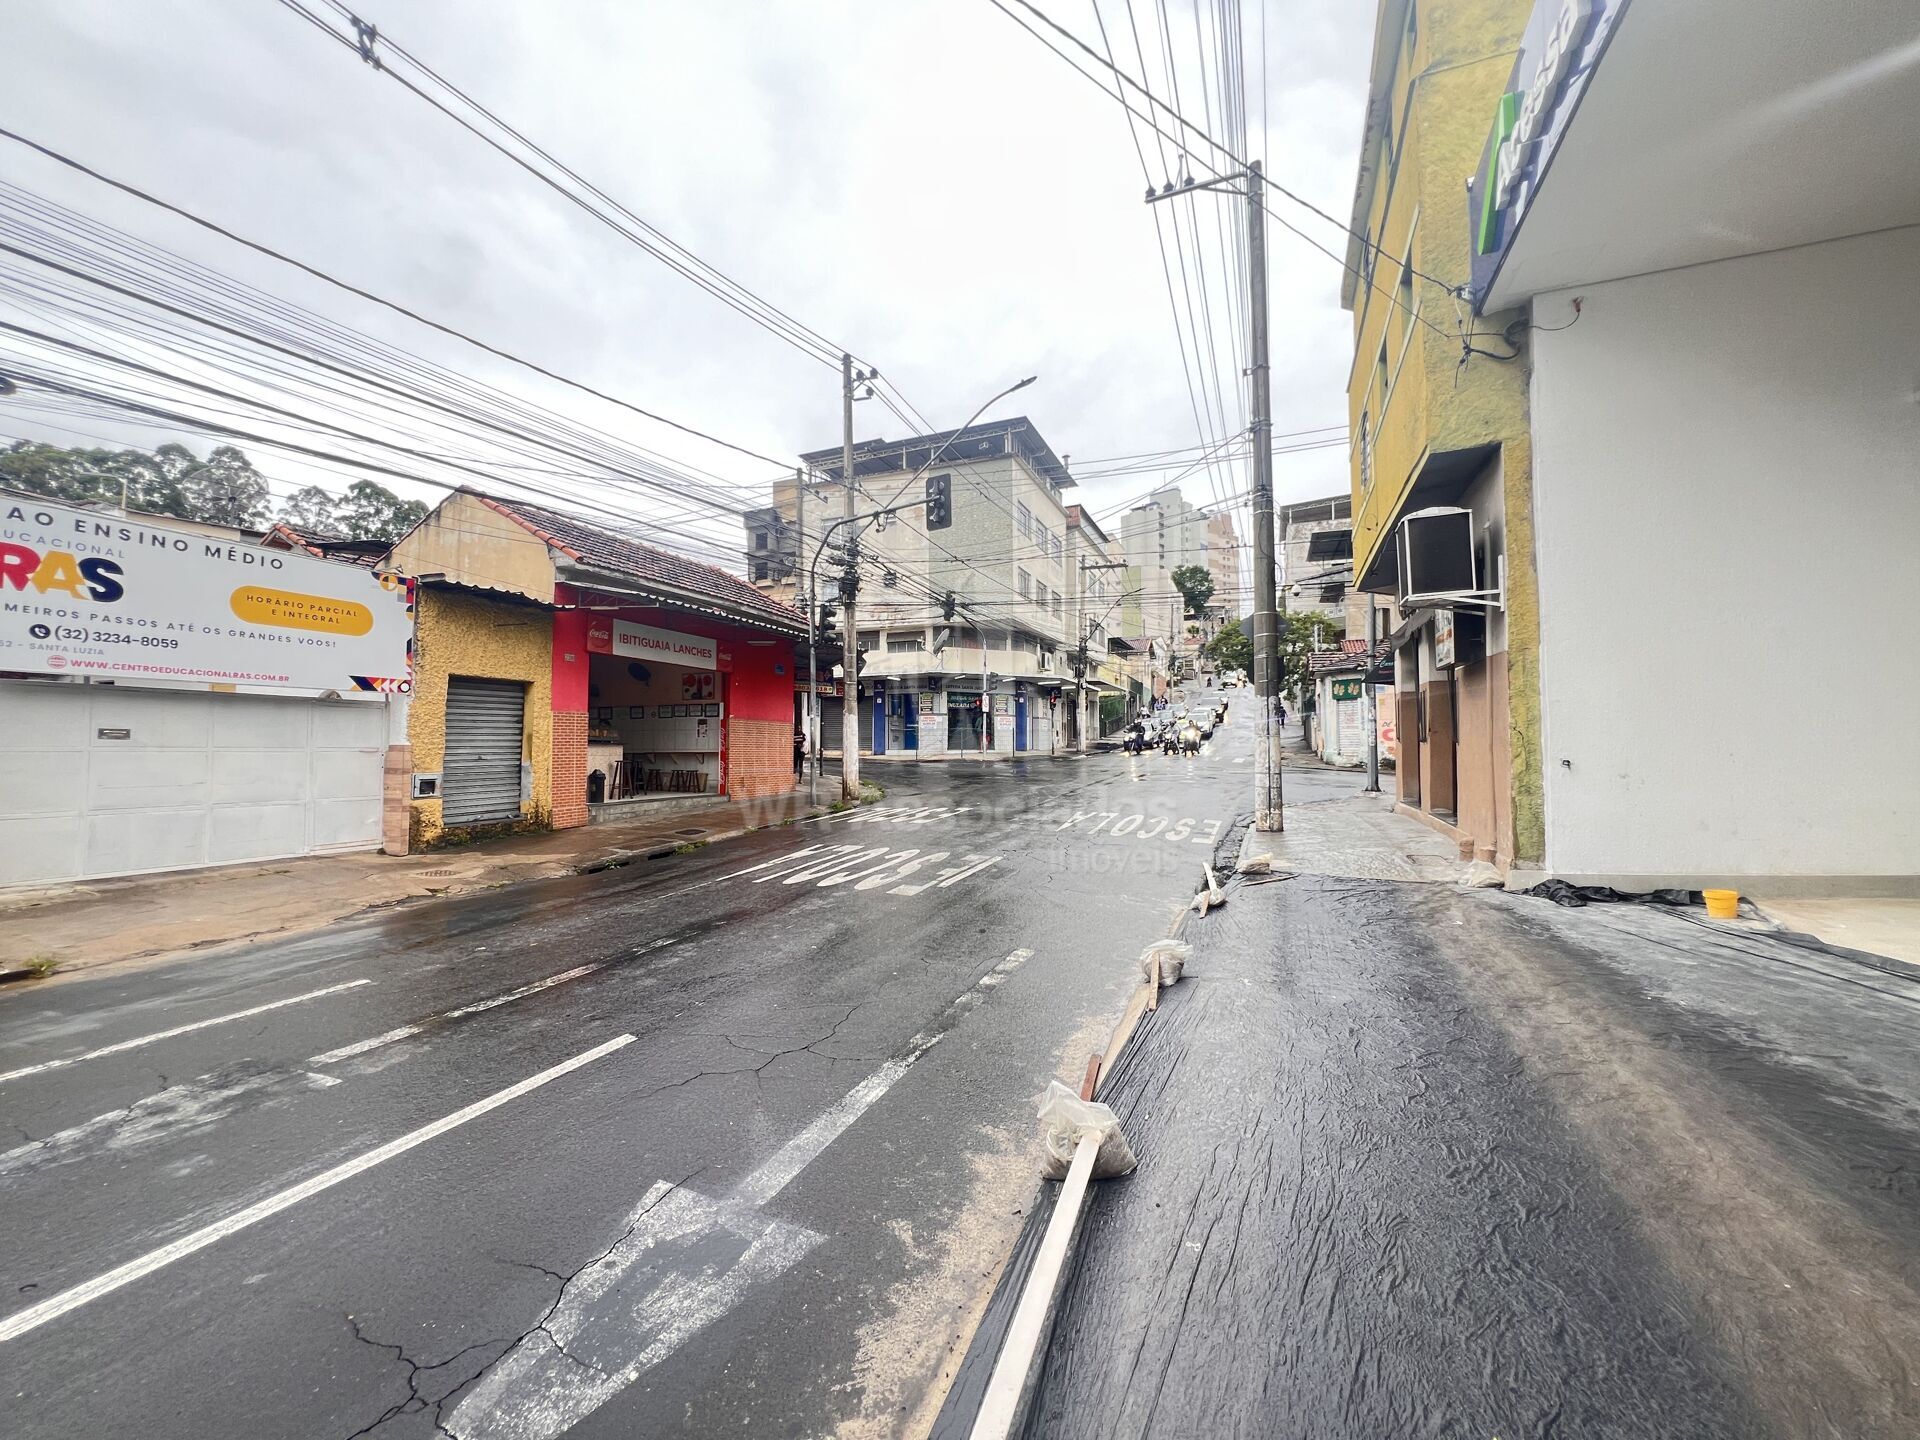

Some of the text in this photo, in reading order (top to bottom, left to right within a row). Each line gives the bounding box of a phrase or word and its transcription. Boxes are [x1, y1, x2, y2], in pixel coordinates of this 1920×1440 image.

[6, 507, 283, 570] AO ENSINO MÉDIO
[246, 594, 358, 617] HORÁRIO PARCIAL
[283, 610, 341, 624] INTEGRAL
[54, 625, 179, 649] (32) 3234-8059
[90, 613, 158, 628] PASSOS
[166, 622, 195, 633] ATÉ
[202, 626, 221, 636] OS
[228, 629, 292, 644] GRANDES
[298, 637, 336, 648] VOOS!
[29, 642, 69, 652] SANTA
[73, 647, 105, 655] LUZIA
[619, 633, 713, 659] IBITIGUAIA LANCHES
[70, 659, 290, 682] WWW.CENTROEDUCACIONALRAS.COM.BR
[1056, 811, 1223, 845] ESCOLA
